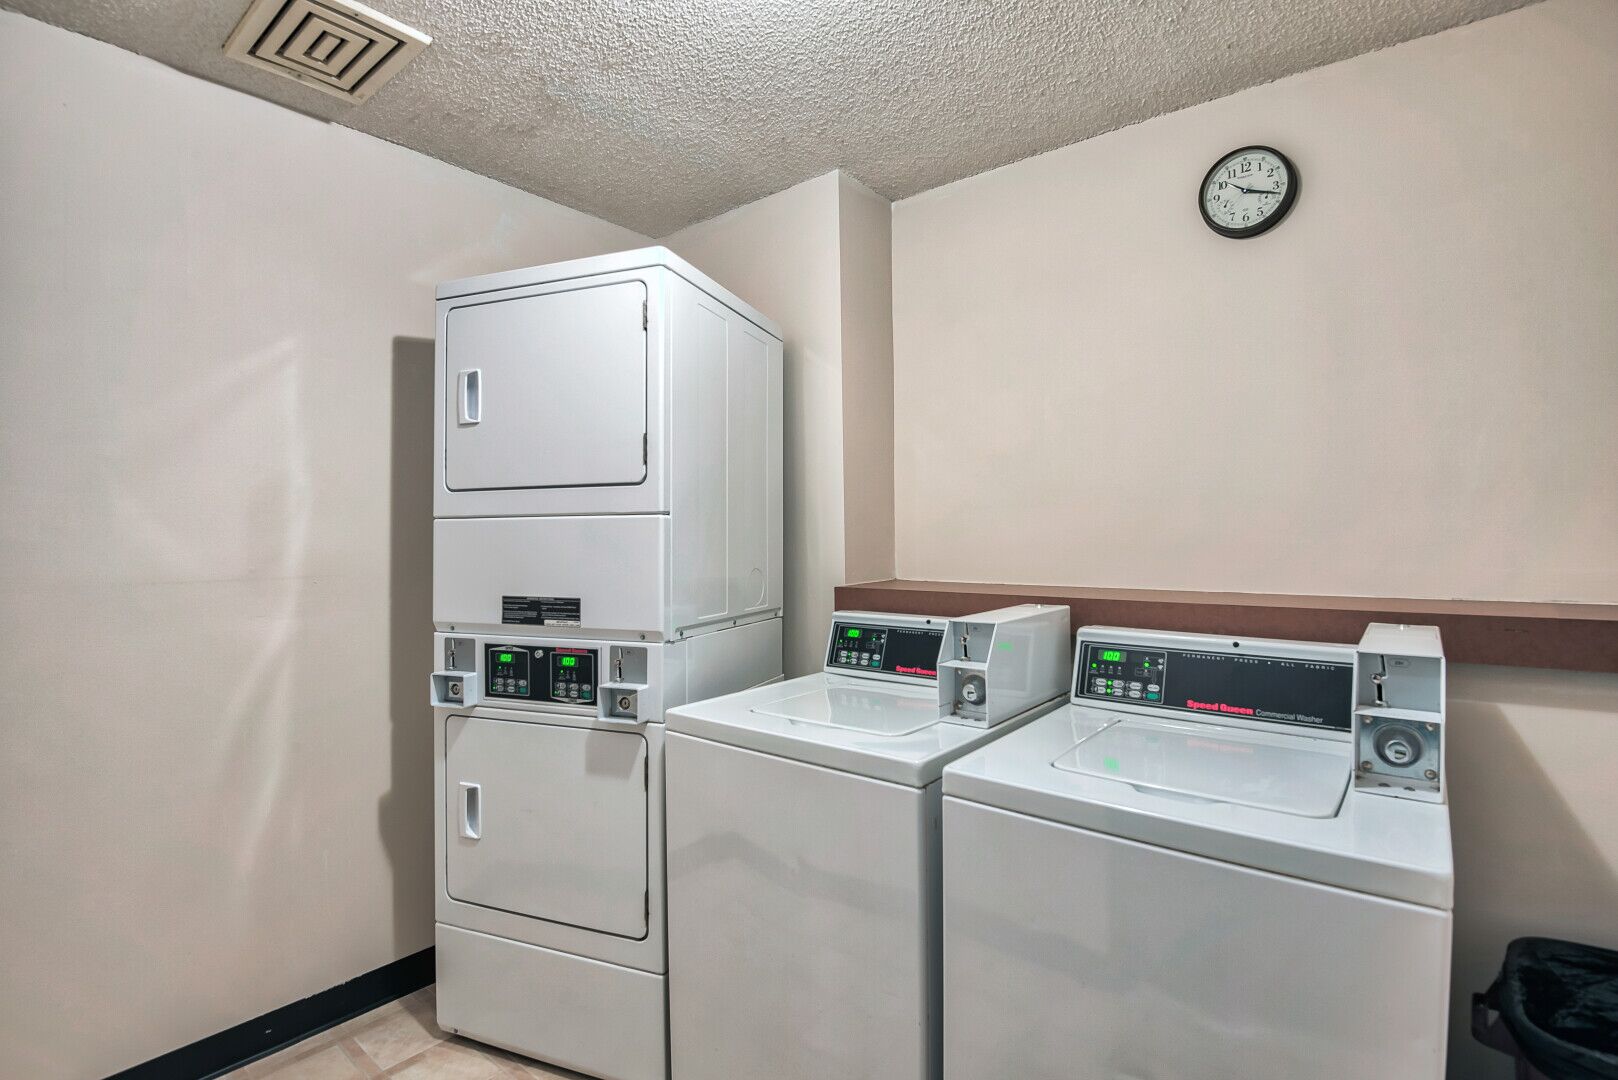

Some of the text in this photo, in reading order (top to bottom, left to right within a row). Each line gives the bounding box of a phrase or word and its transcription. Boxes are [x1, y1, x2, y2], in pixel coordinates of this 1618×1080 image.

[1240, 161, 1252, 174] 12
[1257, 162, 1263, 172] 1
[1227, 169, 1237, 180] 11
[1266, 168, 1275, 178] 2
[1218, 180, 1228, 191] 10
[1272, 180, 1280, 191] 3
[1213, 194, 1221, 204] 9
[1229, 212, 1236, 222] 7
[1242, 212, 1250, 222] 6
[1256, 206, 1264, 217] 5
[1186, 699, 1323, 724] Speed Queen Commercial Washer
